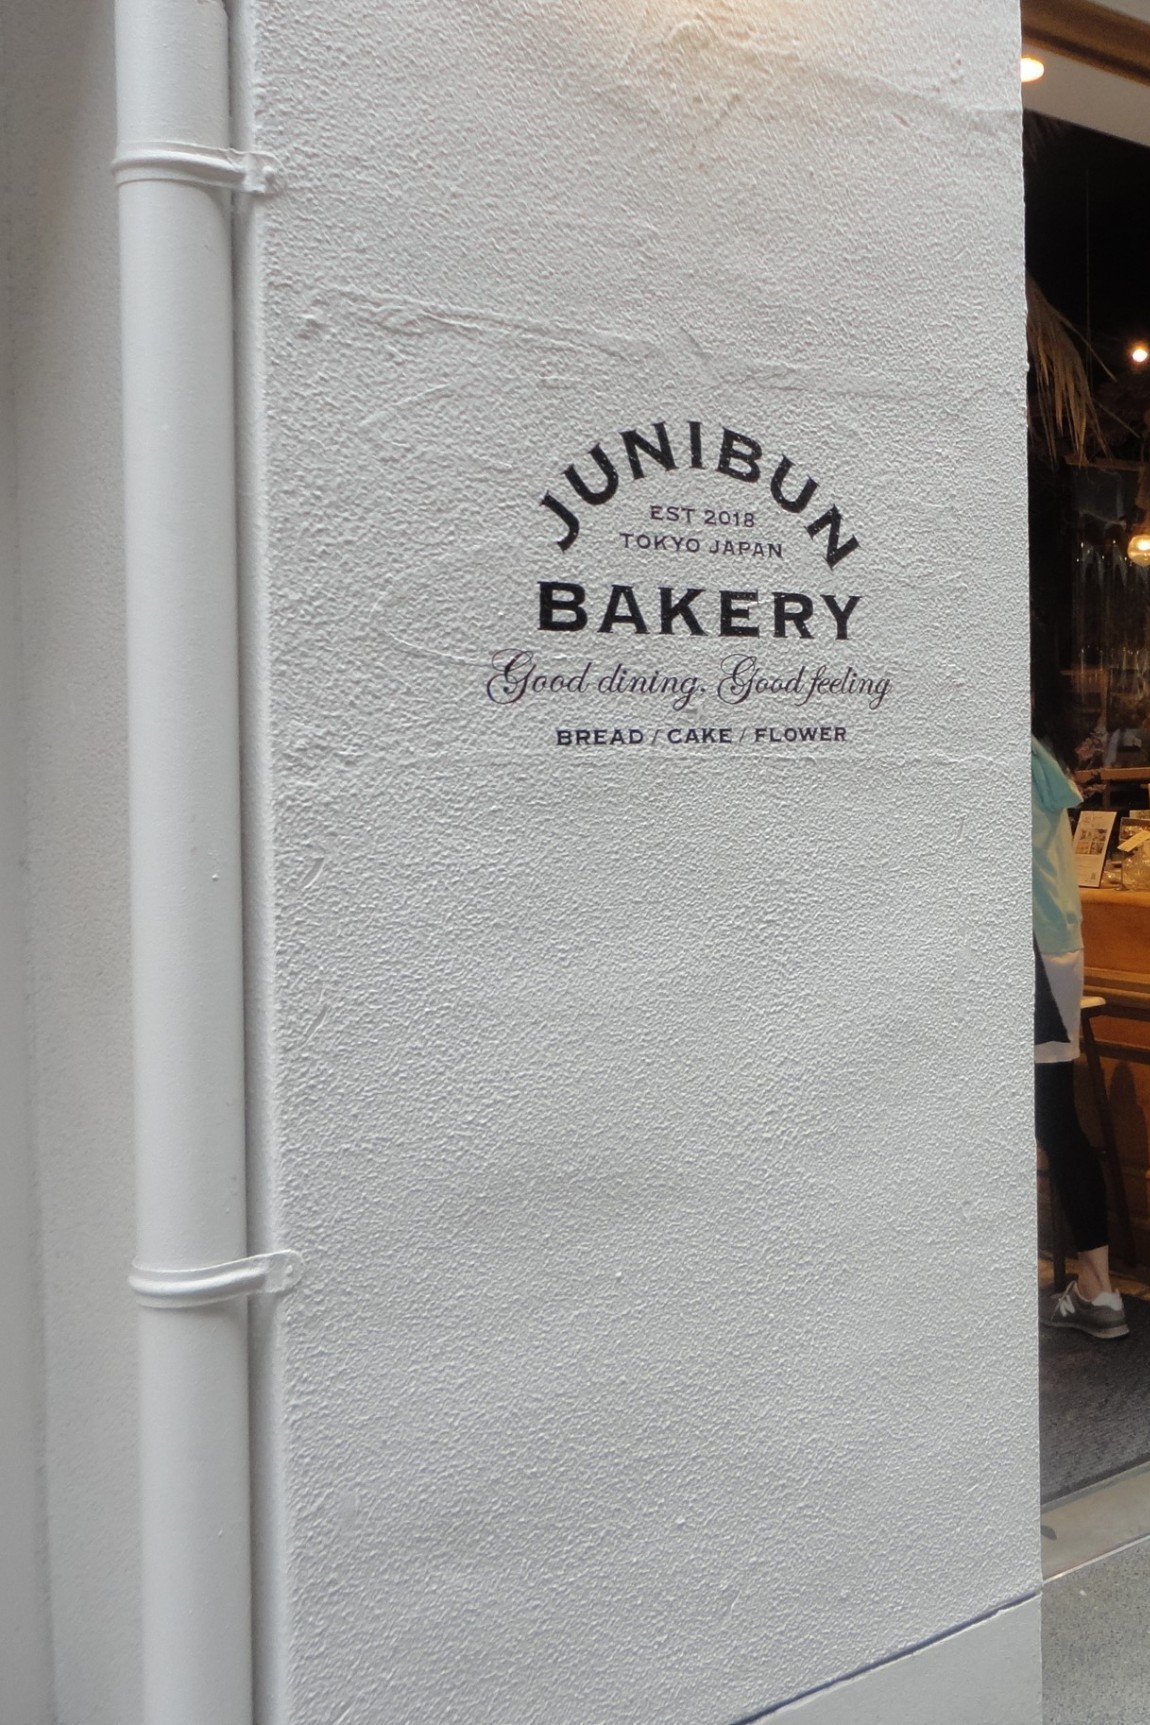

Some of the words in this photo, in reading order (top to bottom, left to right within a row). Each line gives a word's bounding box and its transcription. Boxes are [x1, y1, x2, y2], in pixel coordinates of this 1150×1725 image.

[538, 419, 861, 571] JUNIBUN
[649, 504, 696, 525] EST
[703, 509, 756, 528] 2018
[619, 532, 701, 553] TOKYO
[709, 539, 783, 559] JAPAN
[536, 580, 864, 641] BAKERY
[486, 648, 593, 705] Good
[716, 653, 806, 705] Good
[795, 664, 893, 711] feeling
[555, 728, 645, 747] BREAD
[666, 728, 733, 746] CAKE
[754, 725, 847, 743] FLOWER
